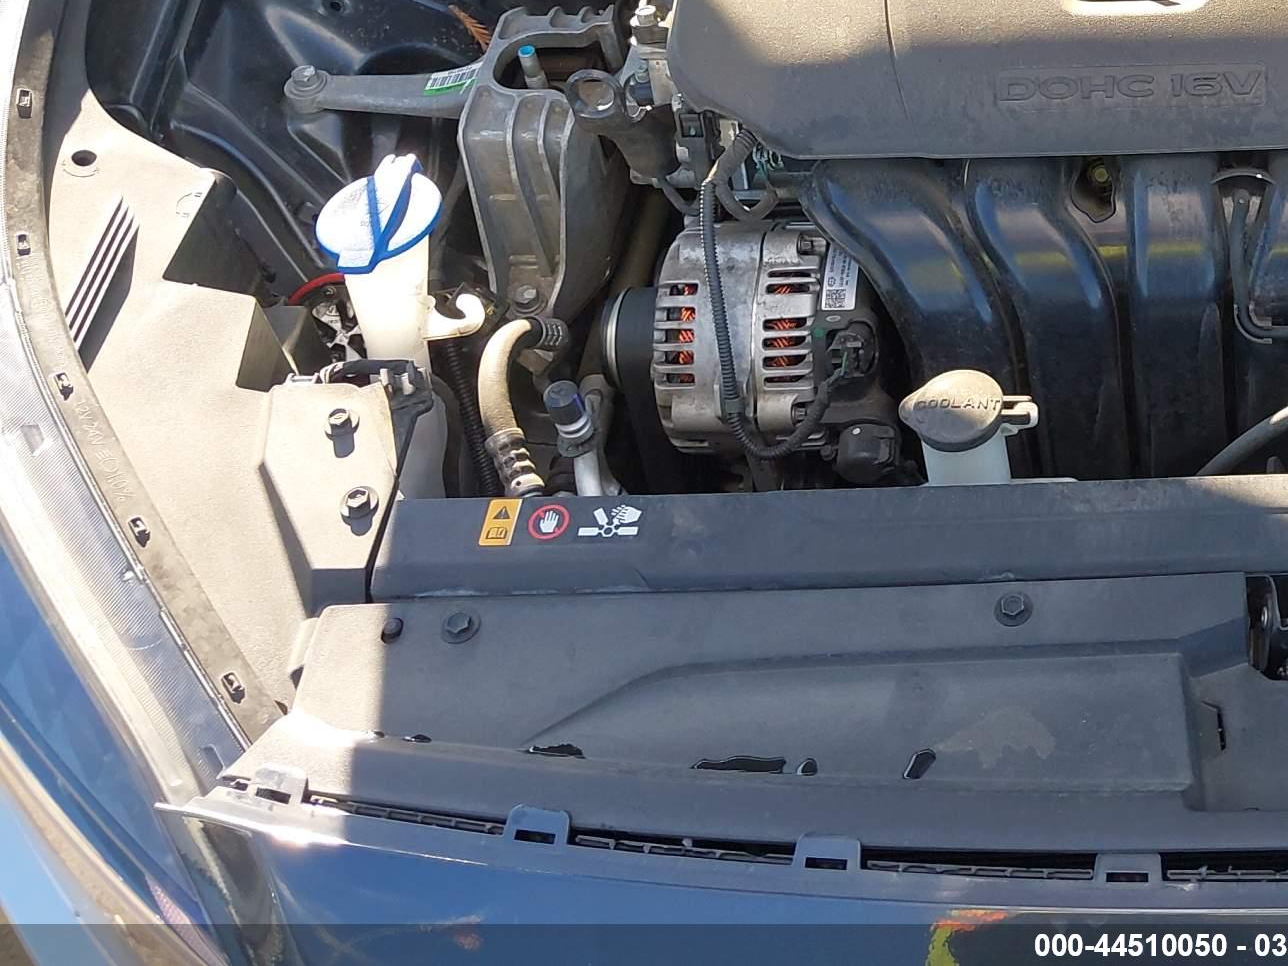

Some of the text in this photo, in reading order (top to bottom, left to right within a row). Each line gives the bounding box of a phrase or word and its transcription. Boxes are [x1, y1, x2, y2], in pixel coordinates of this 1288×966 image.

[999, 71, 1262, 102] DOHC 16V
[913, 397, 1001, 411] COOLANT
